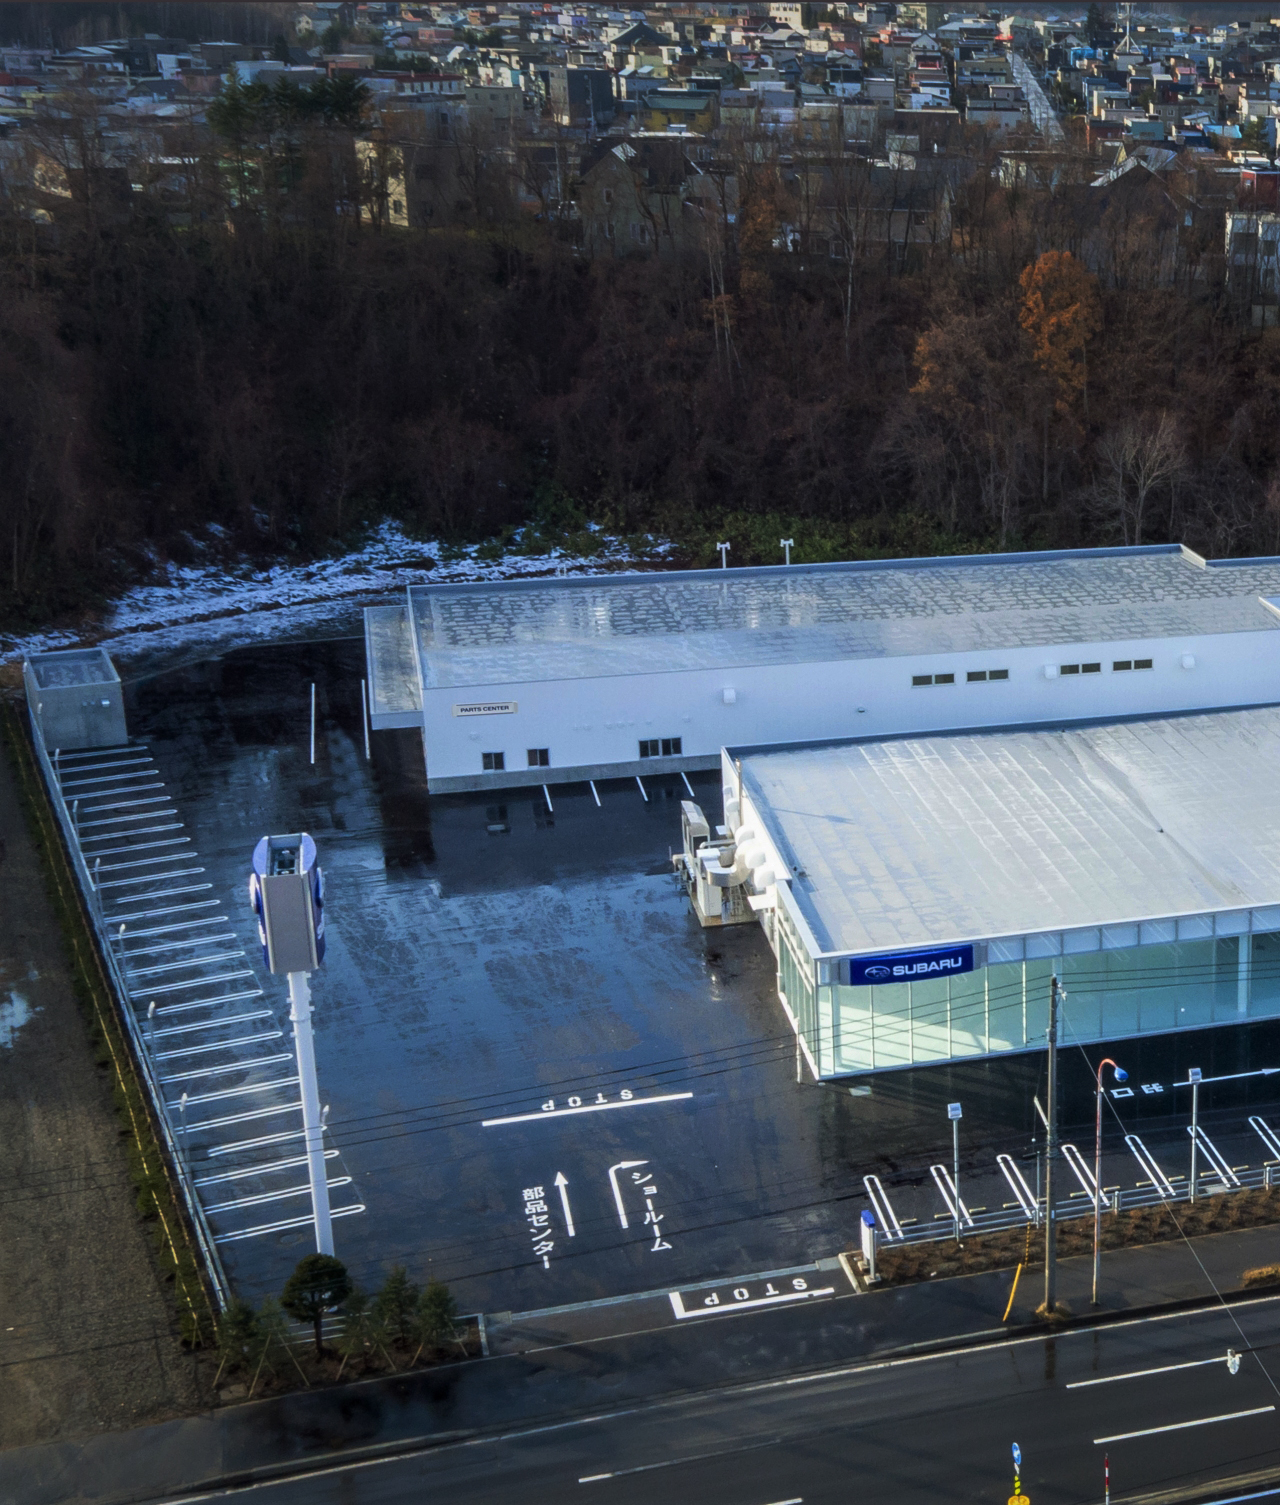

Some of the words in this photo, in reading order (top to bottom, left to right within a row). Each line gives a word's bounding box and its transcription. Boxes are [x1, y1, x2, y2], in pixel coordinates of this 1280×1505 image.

[892, 956, 962, 976] SUBARU
[541, 1088, 634, 1112] STOP
[631, 1172, 673, 1252] ショールーム
[522, 1186, 555, 1269] 部品センター
[704, 1278, 808, 1306] STOP
